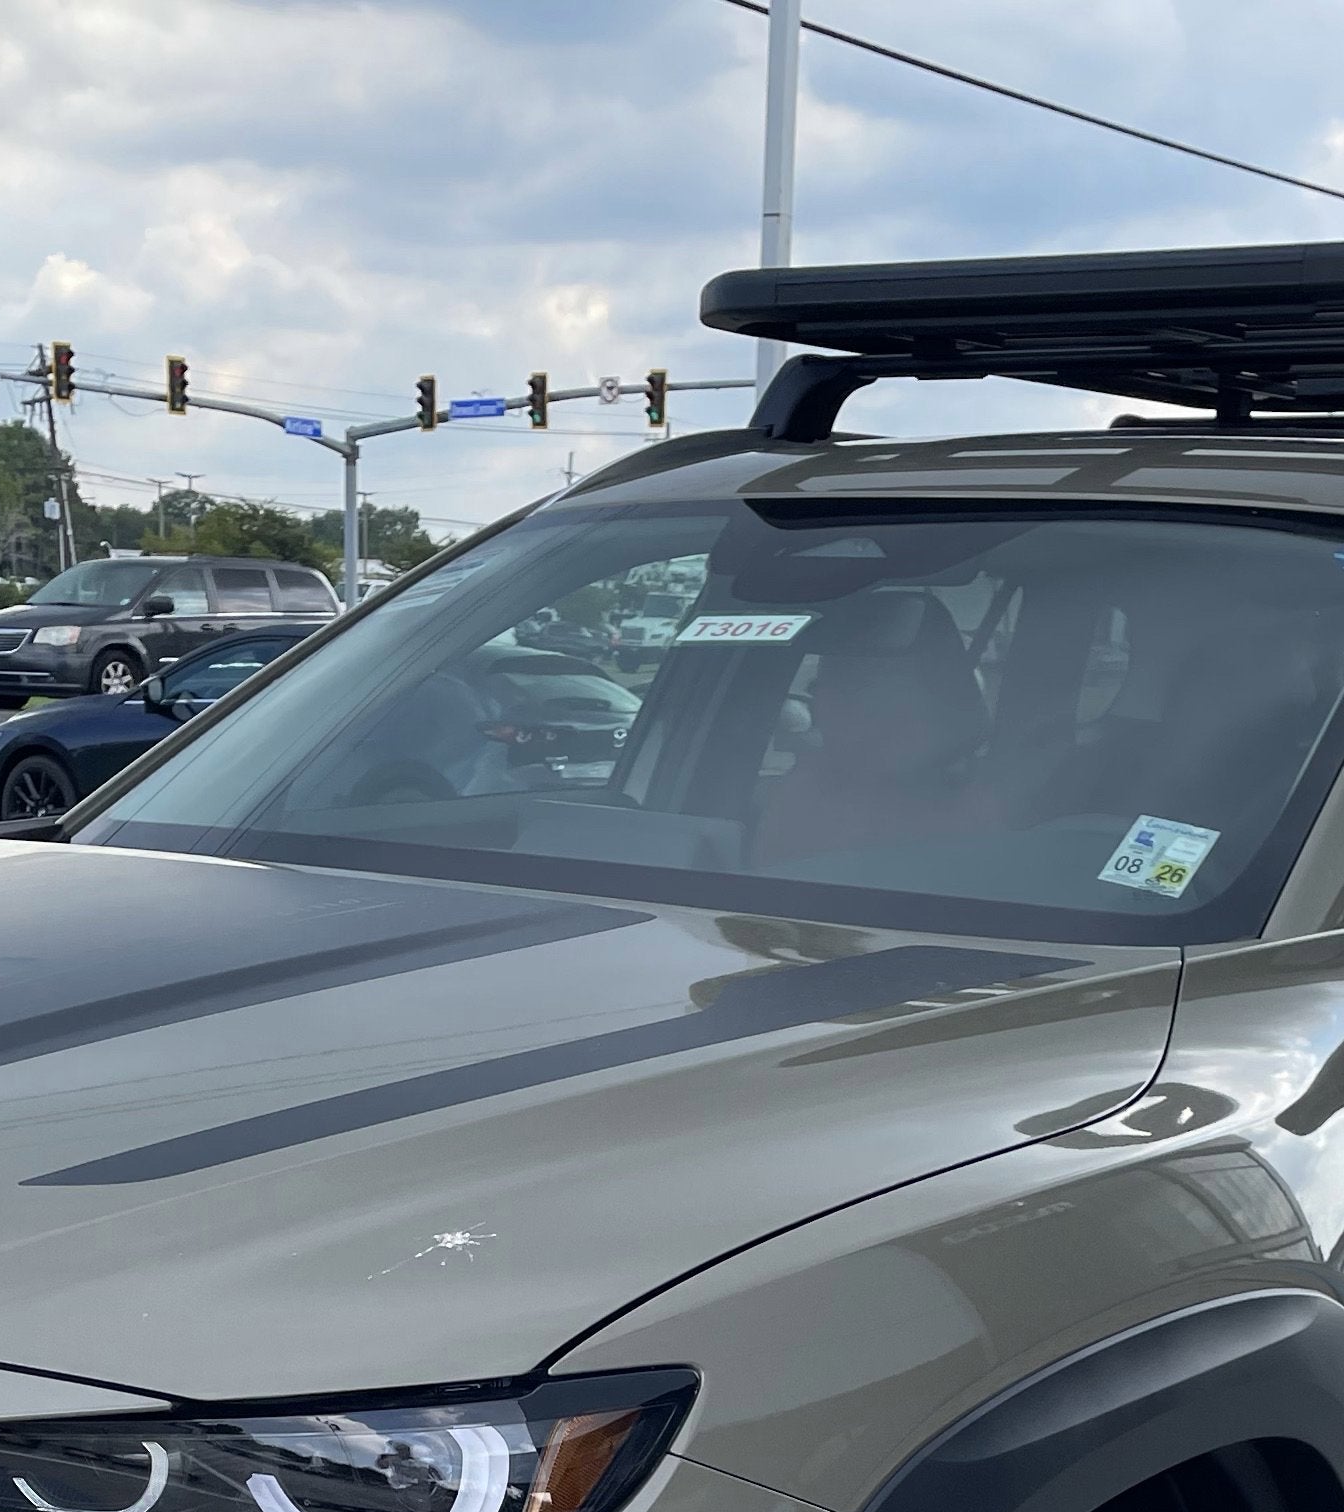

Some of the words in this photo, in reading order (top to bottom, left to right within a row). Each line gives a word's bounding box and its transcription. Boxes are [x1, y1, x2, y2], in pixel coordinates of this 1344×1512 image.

[694, 621, 794, 637] T3016
[1114, 855, 1144, 874] 08
[1155, 864, 1187, 884] 26
